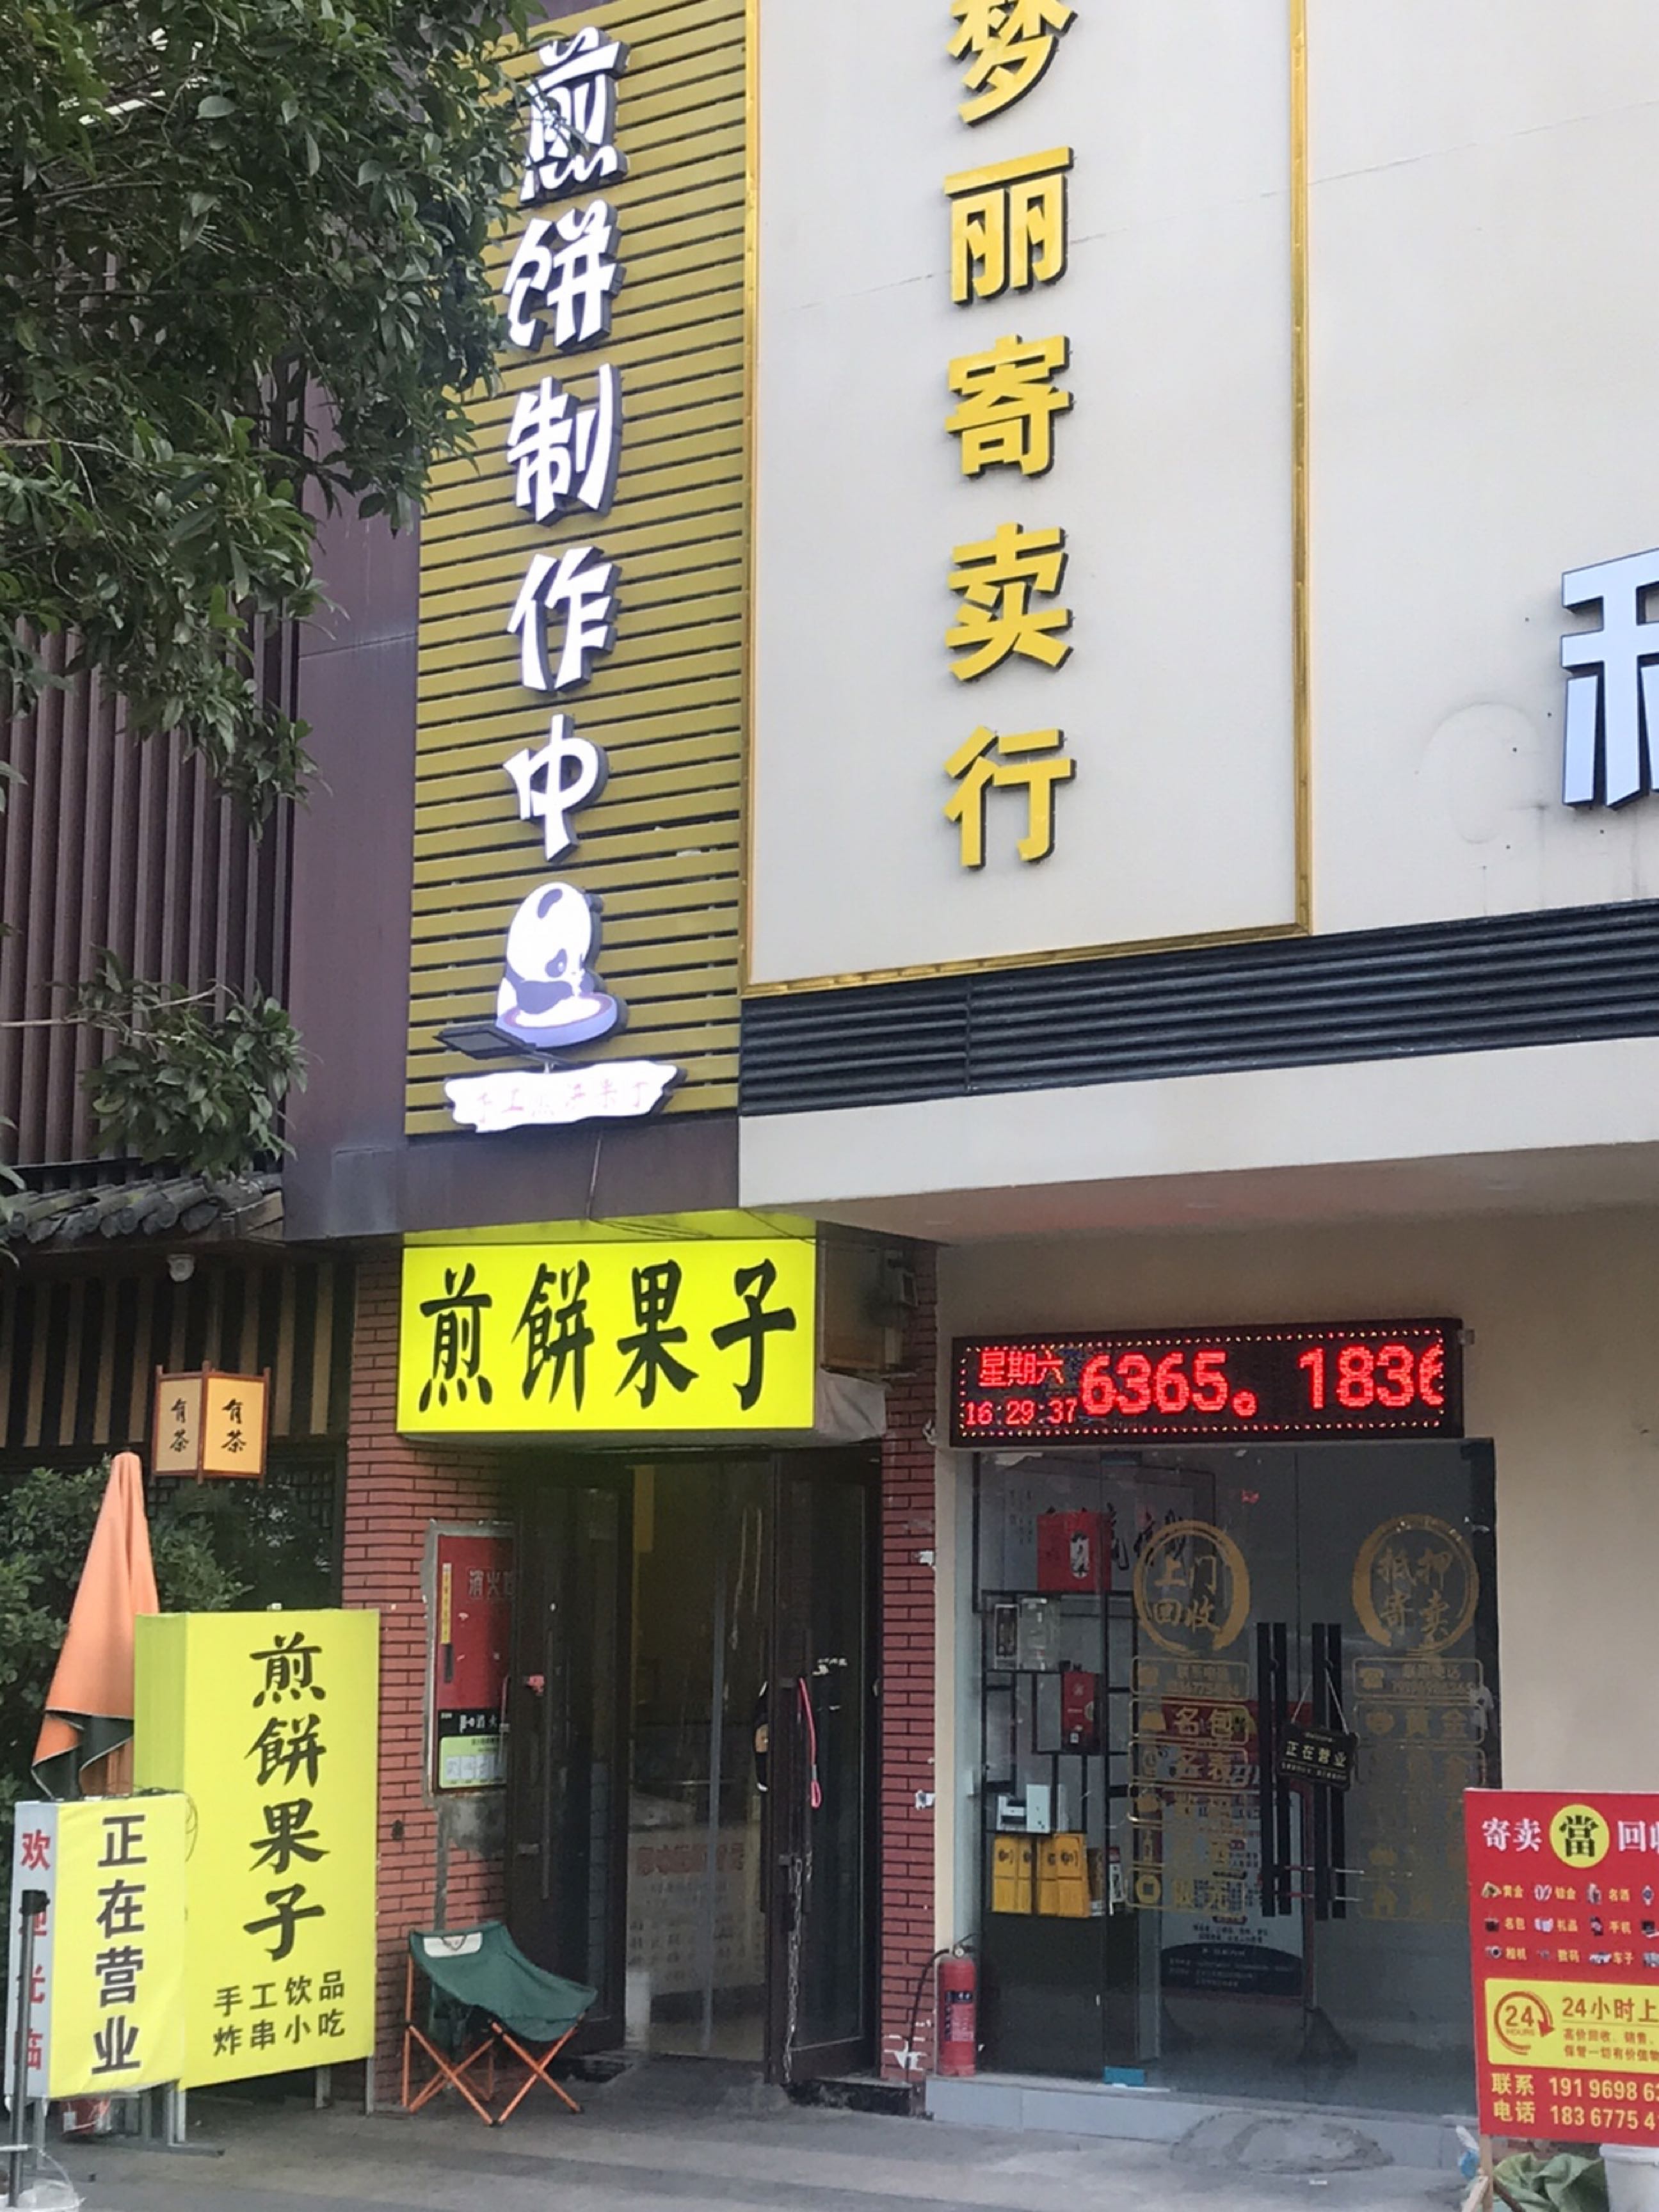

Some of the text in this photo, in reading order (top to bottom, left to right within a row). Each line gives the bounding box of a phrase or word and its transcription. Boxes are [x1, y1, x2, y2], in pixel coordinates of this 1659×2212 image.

[503, 26, 626, 863] 煎饼制作中
[419, 1258, 797, 1412] 煎餅果子
[979, 1350, 1064, 1388] 星期六
[170, 1398, 189, 1452] 有茶
[221, 1398, 246, 1453] 有茶
[1155, 1554, 1216, 1594] 上门
[1155, 1595, 1221, 1633] 回收
[244, 1631, 330, 1961] 煎餅果子
[1482, 1817, 1542, 1852] 寄卖
[91, 1813, 148, 2076] 正在营业
[214, 1969, 346, 2017] 手工饮品
[213, 2008, 346, 2057] 炸串小吃
[1505, 2005, 1534, 2027] 24
[1491, 2073, 1535, 2096] 联系
[1549, 2077, 1583, 2097] 191
[1589, 2079, 1638, 2101] 9698
[1493, 2099, 1535, 2124] 电话
[1550, 2104, 1585, 2126] 183
[1591, 2107, 1639, 2130] 6775
